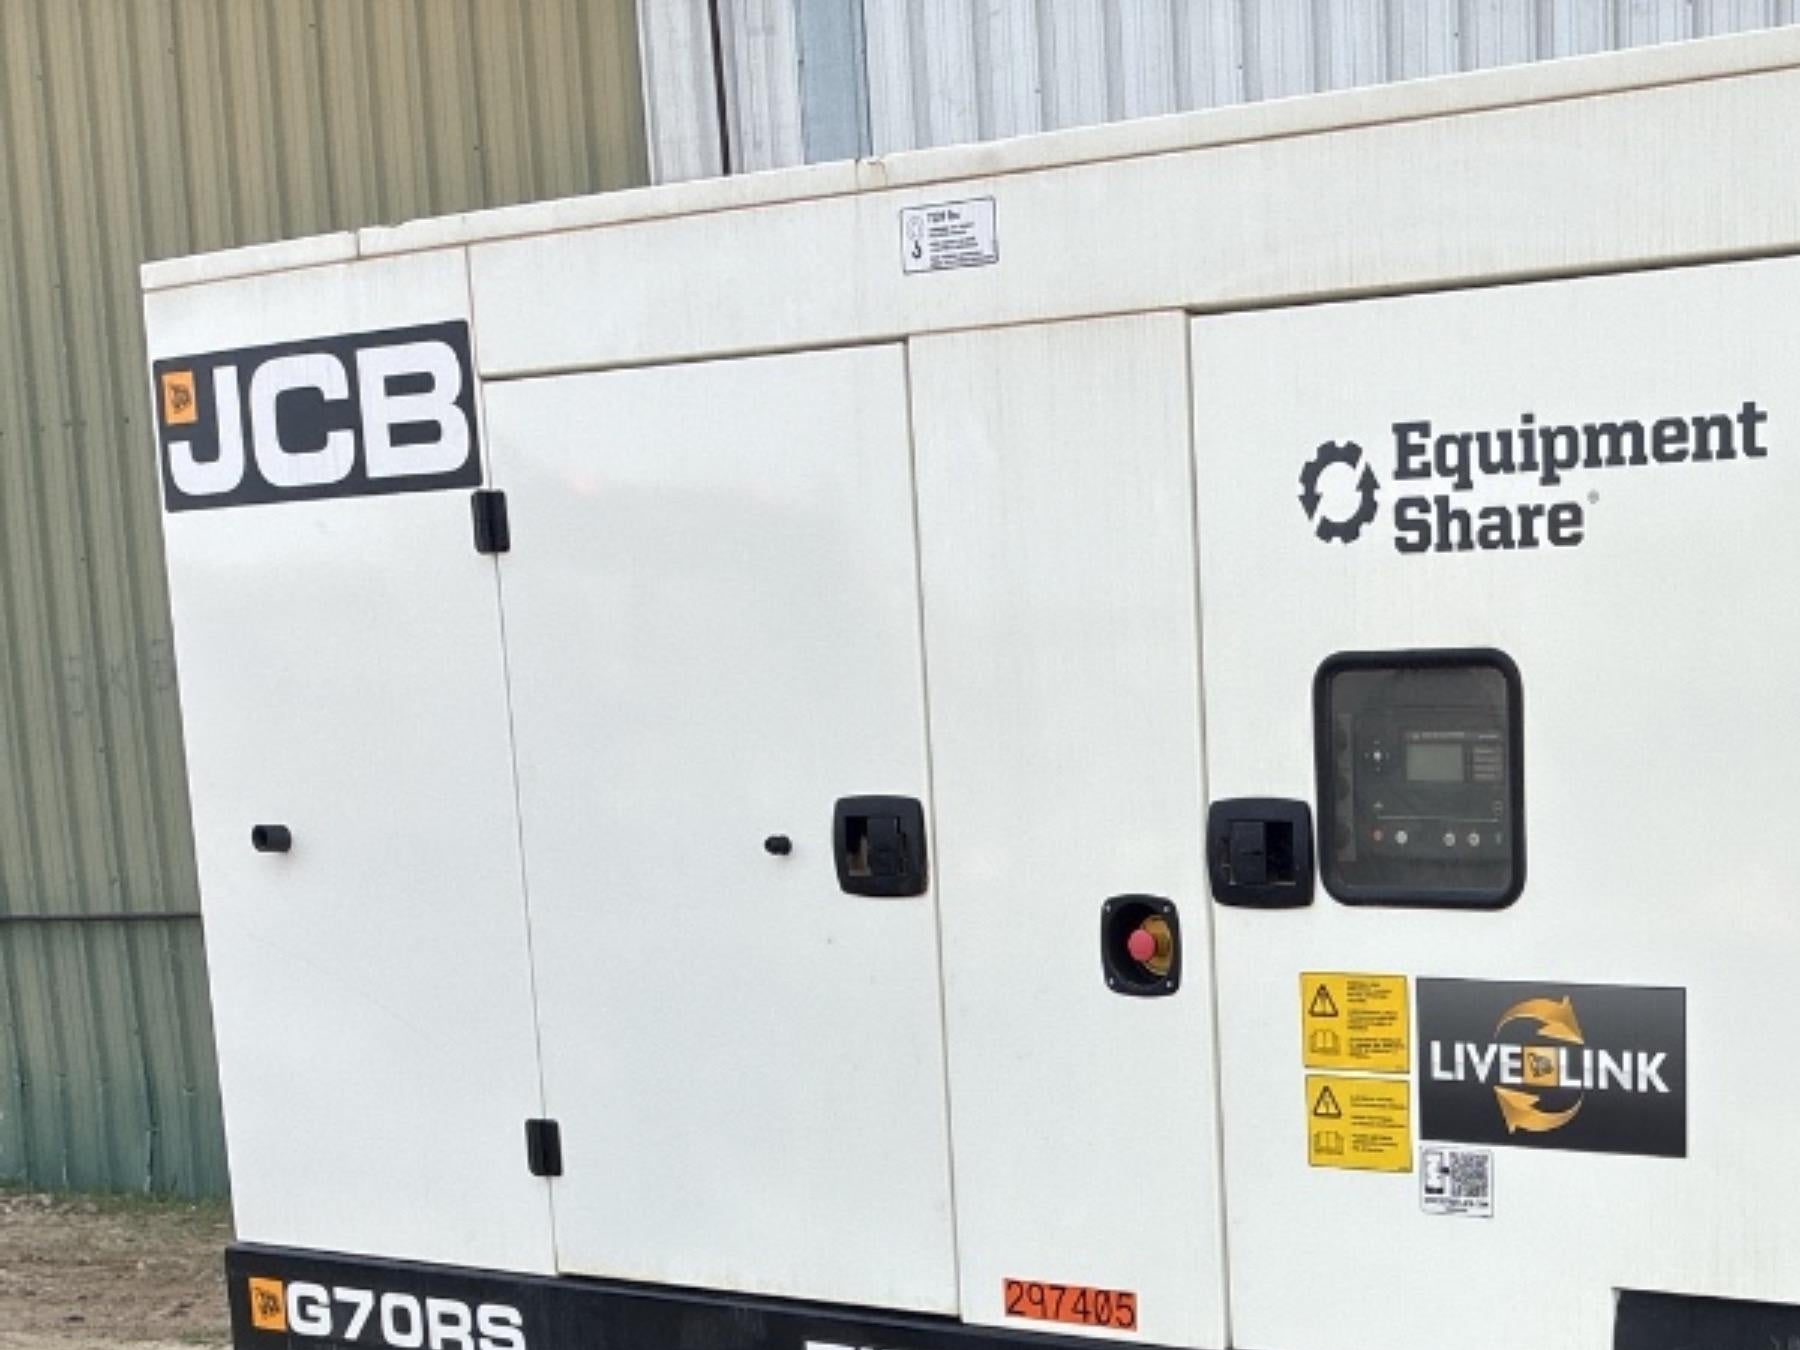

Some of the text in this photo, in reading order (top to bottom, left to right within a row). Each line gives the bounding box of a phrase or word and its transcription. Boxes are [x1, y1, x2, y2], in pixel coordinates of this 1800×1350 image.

[166, 340, 469, 495] JCB
[1392, 401, 1767, 490] Equipment
[1394, 495, 1584, 554] Share
[1430, 1040, 1670, 1093] LIVE LINK
[1006, 1280, 1136, 1328] 297405
